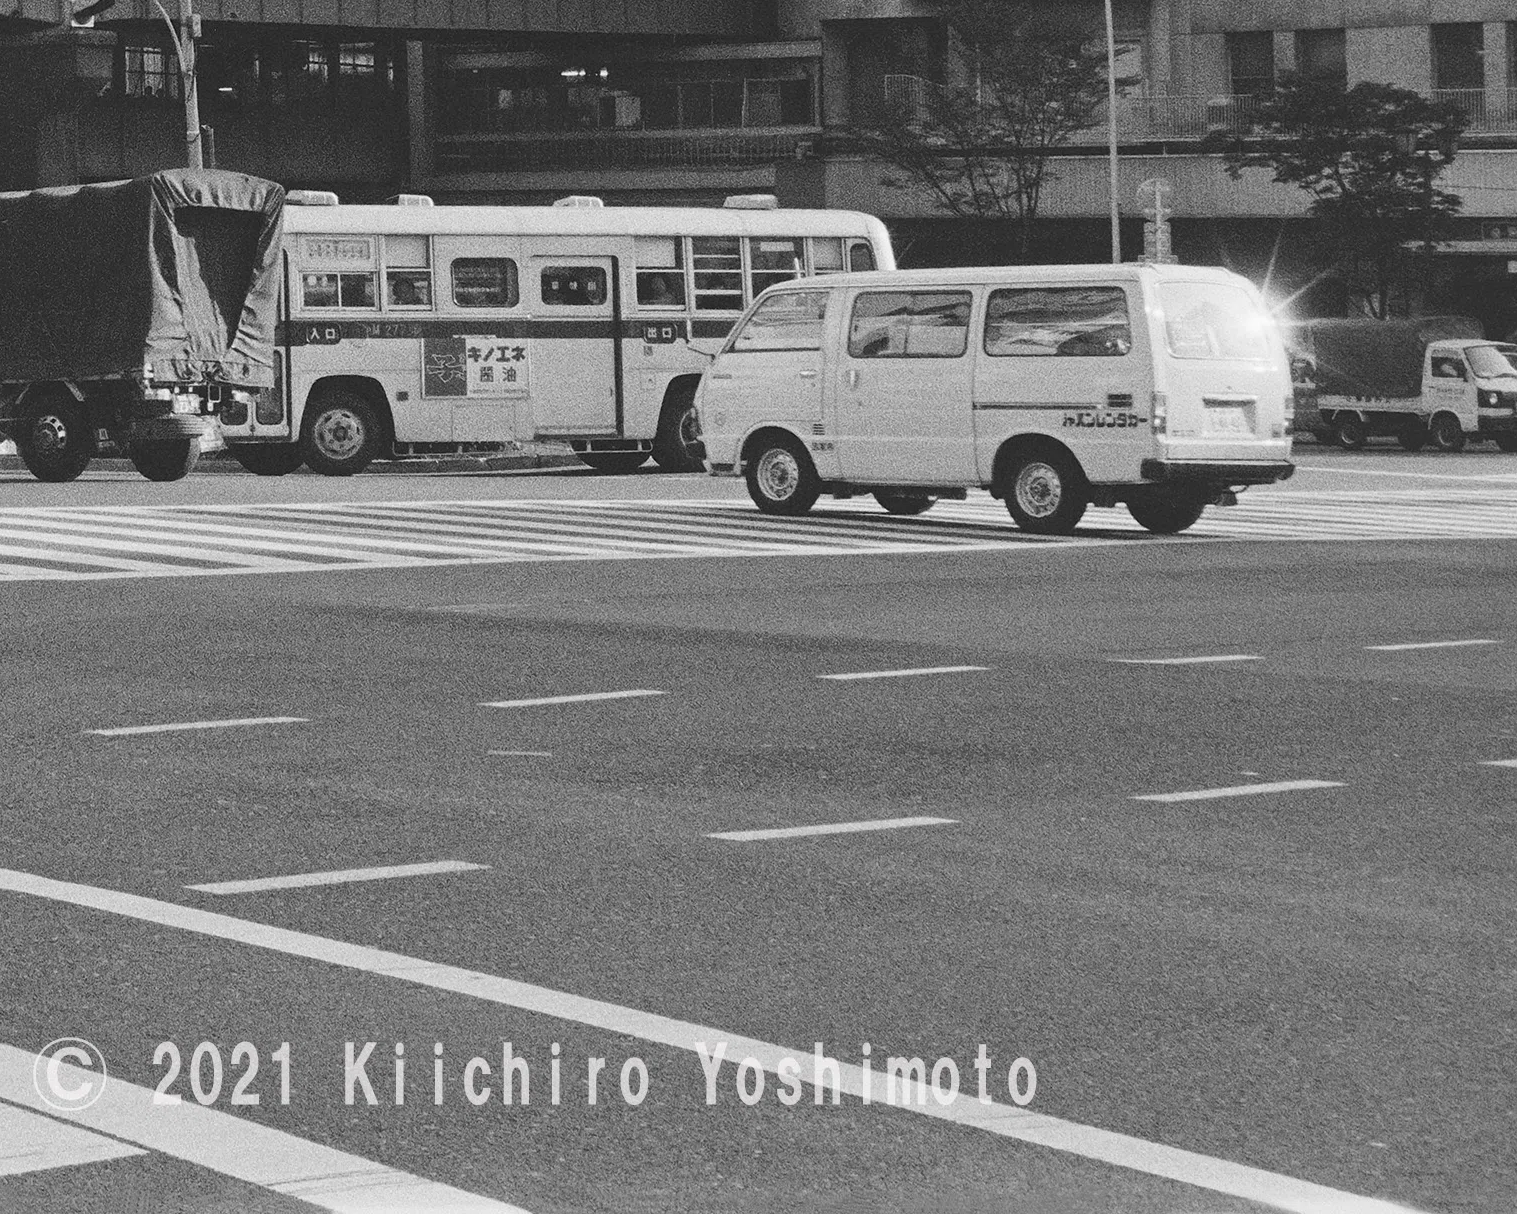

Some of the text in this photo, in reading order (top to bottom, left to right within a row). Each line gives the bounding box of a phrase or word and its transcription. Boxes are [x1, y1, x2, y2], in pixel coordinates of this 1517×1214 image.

[310, 327, 336, 340] 入口
[647, 327, 672, 339] 出口
[467, 346, 526, 362] キノエネ
